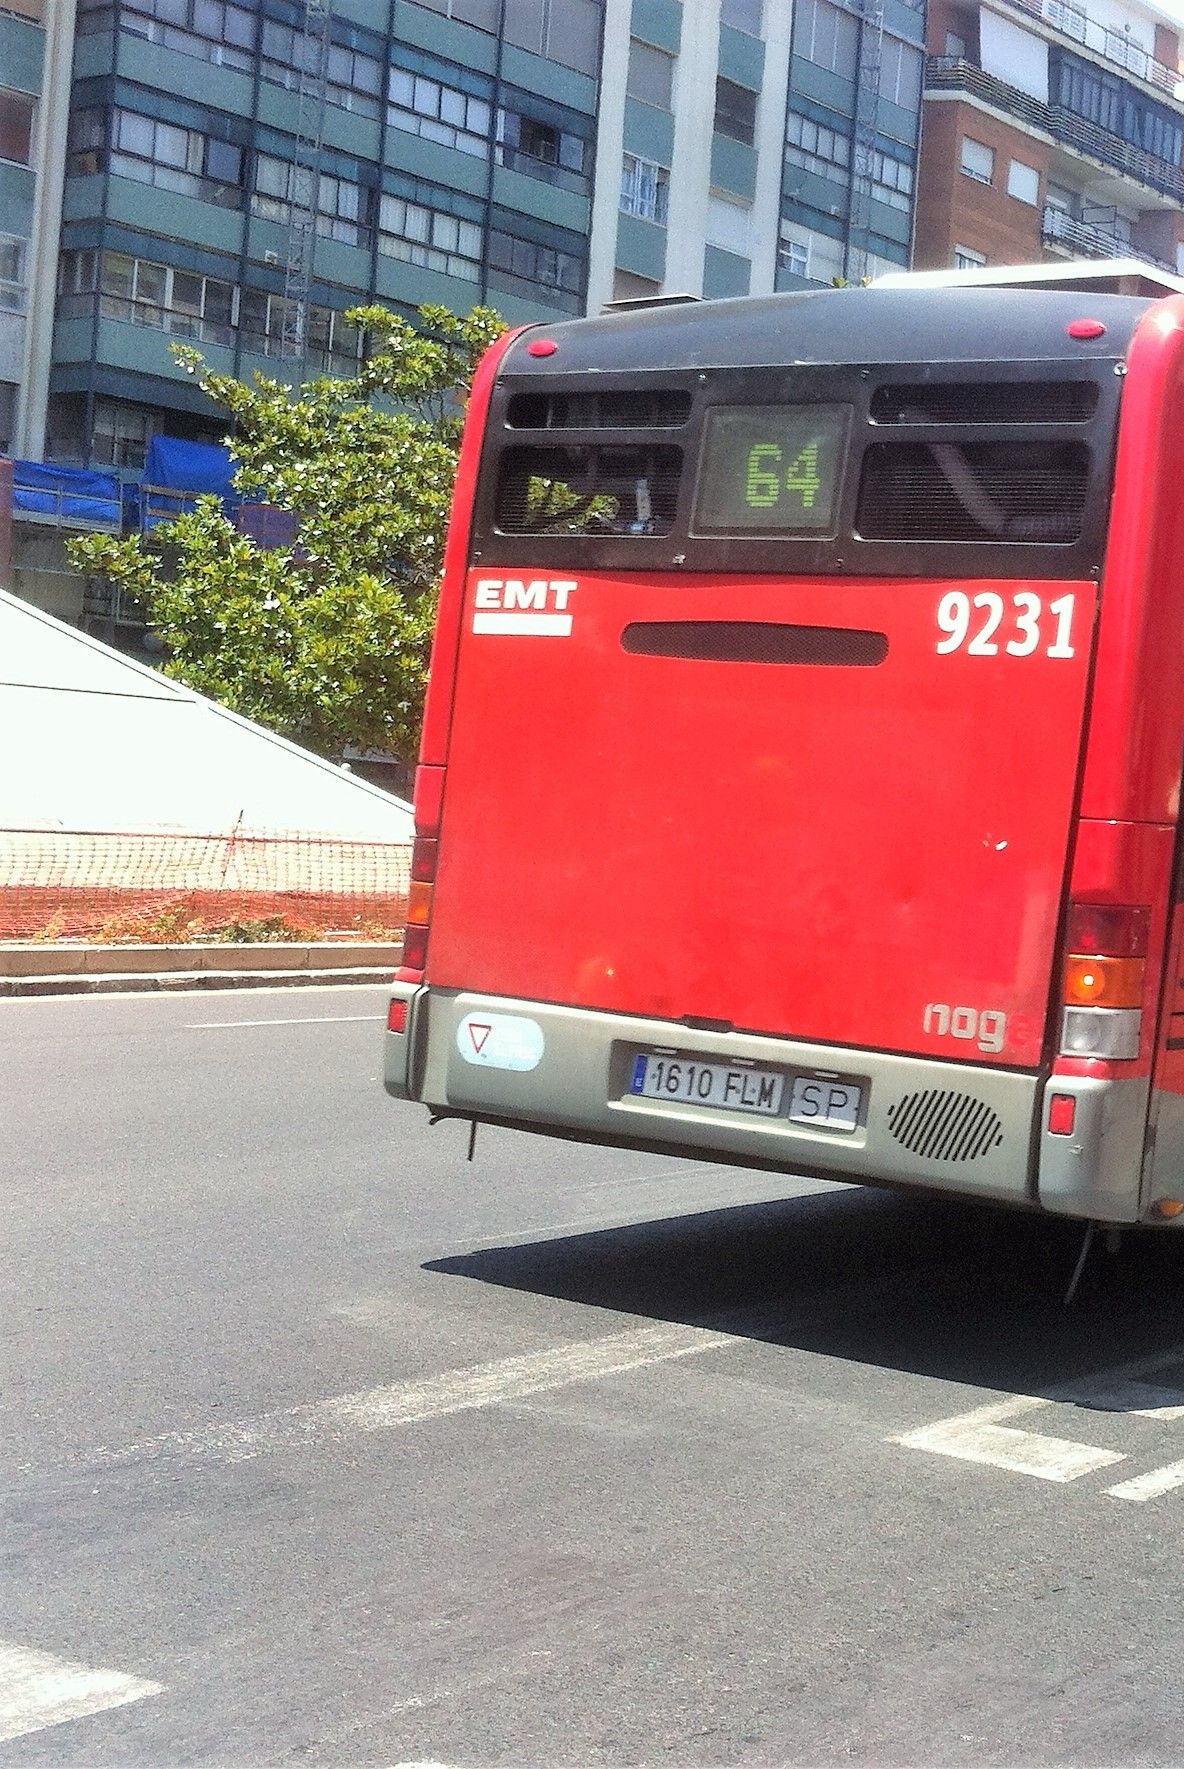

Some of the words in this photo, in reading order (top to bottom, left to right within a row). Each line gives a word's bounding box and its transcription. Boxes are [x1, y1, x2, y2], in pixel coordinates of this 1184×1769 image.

[745, 443, 820, 508] 64
[475, 580, 579, 611] EMT
[936, 591, 1075, 659] 9231
[655, 1061, 713, 1099] 1610
[723, 1072, 775, 1109] FLM
[801, 1085, 848, 1121] SP
